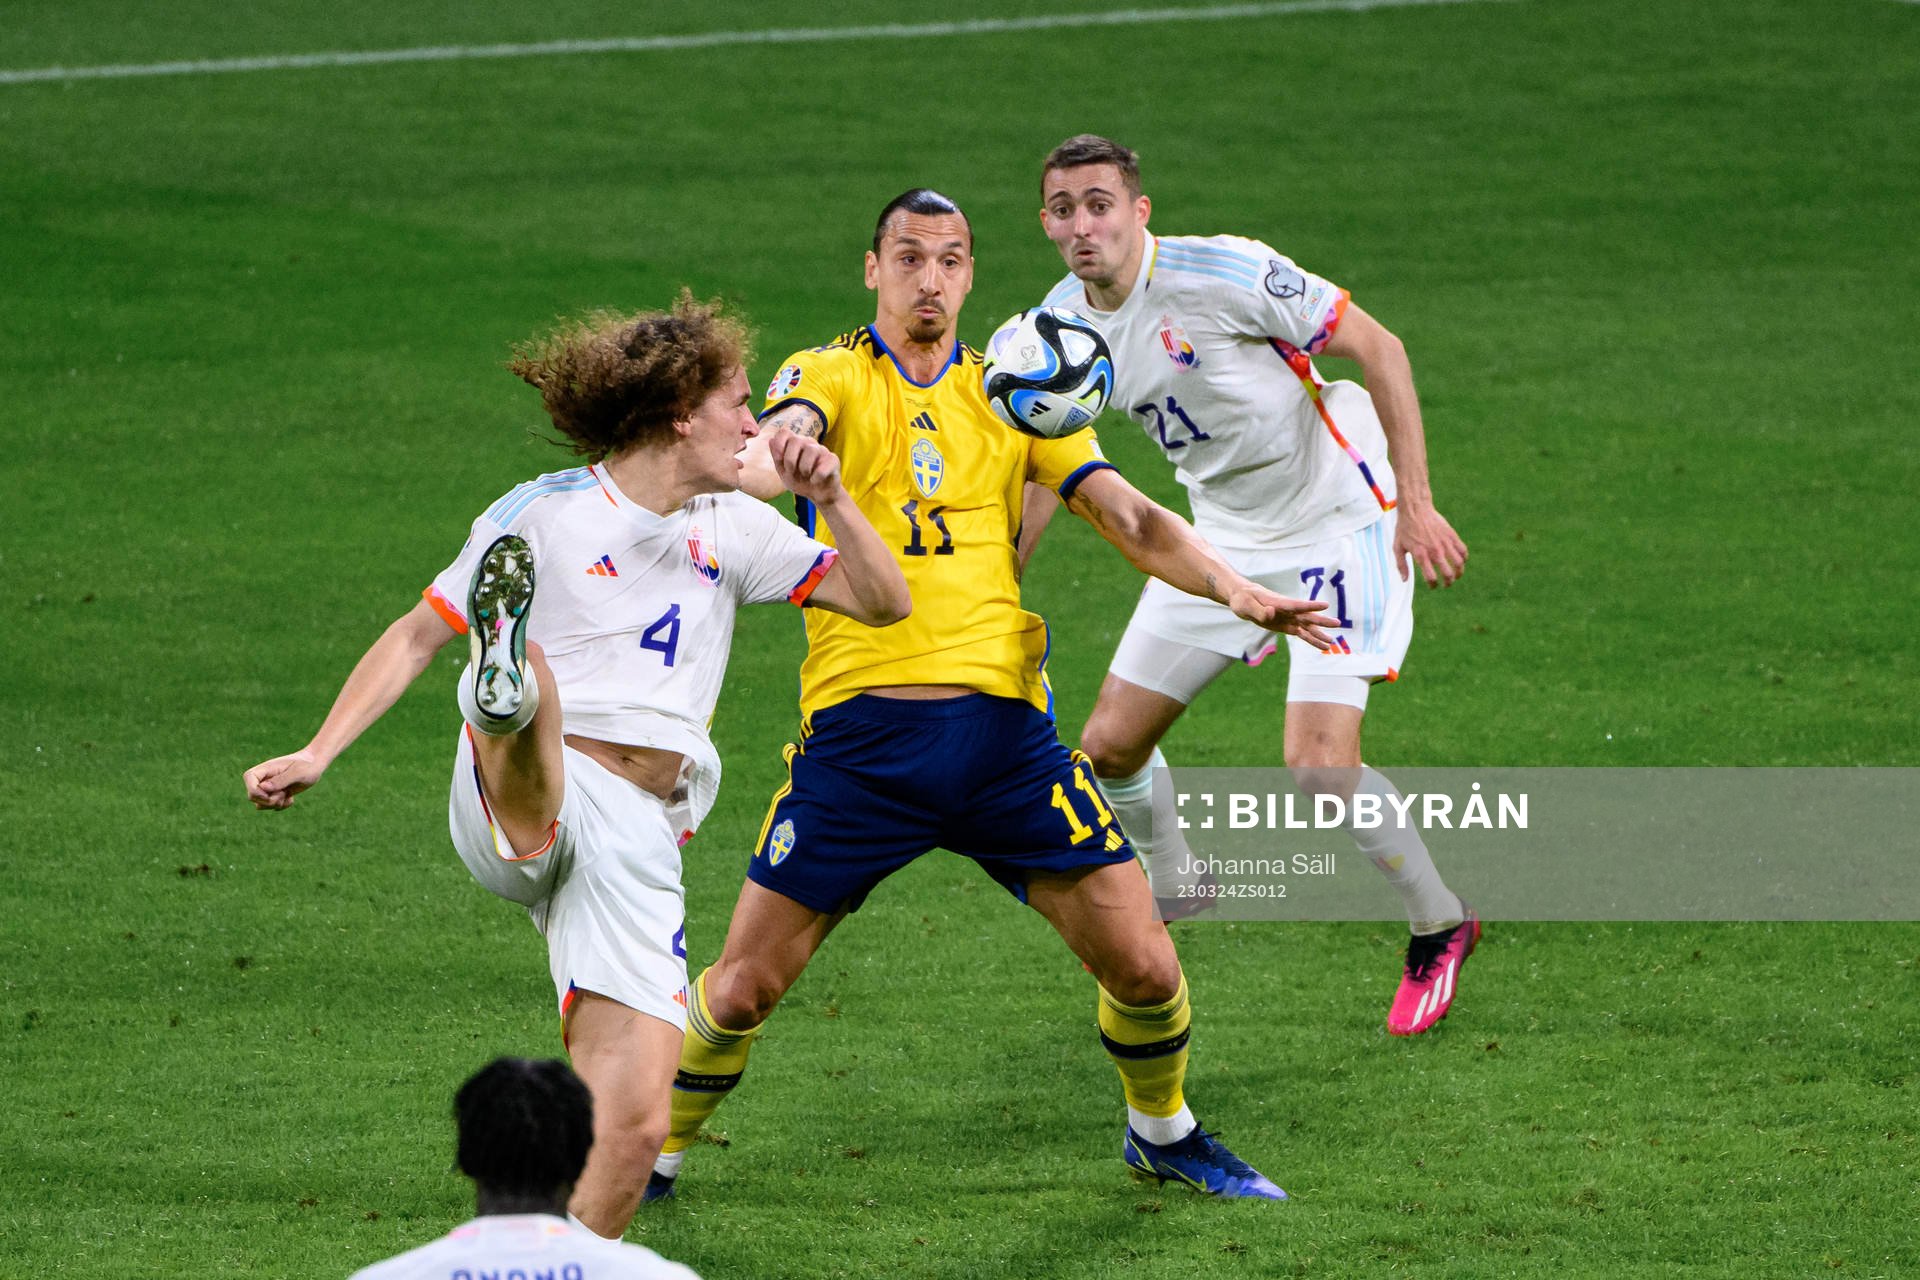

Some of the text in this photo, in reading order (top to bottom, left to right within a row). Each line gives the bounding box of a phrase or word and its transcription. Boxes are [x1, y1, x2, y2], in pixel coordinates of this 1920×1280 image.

[1134, 396, 1211, 449] 21
[901, 499, 954, 556] 11
[640, 603, 681, 667] 4
[1051, 766, 1112, 845] 11
